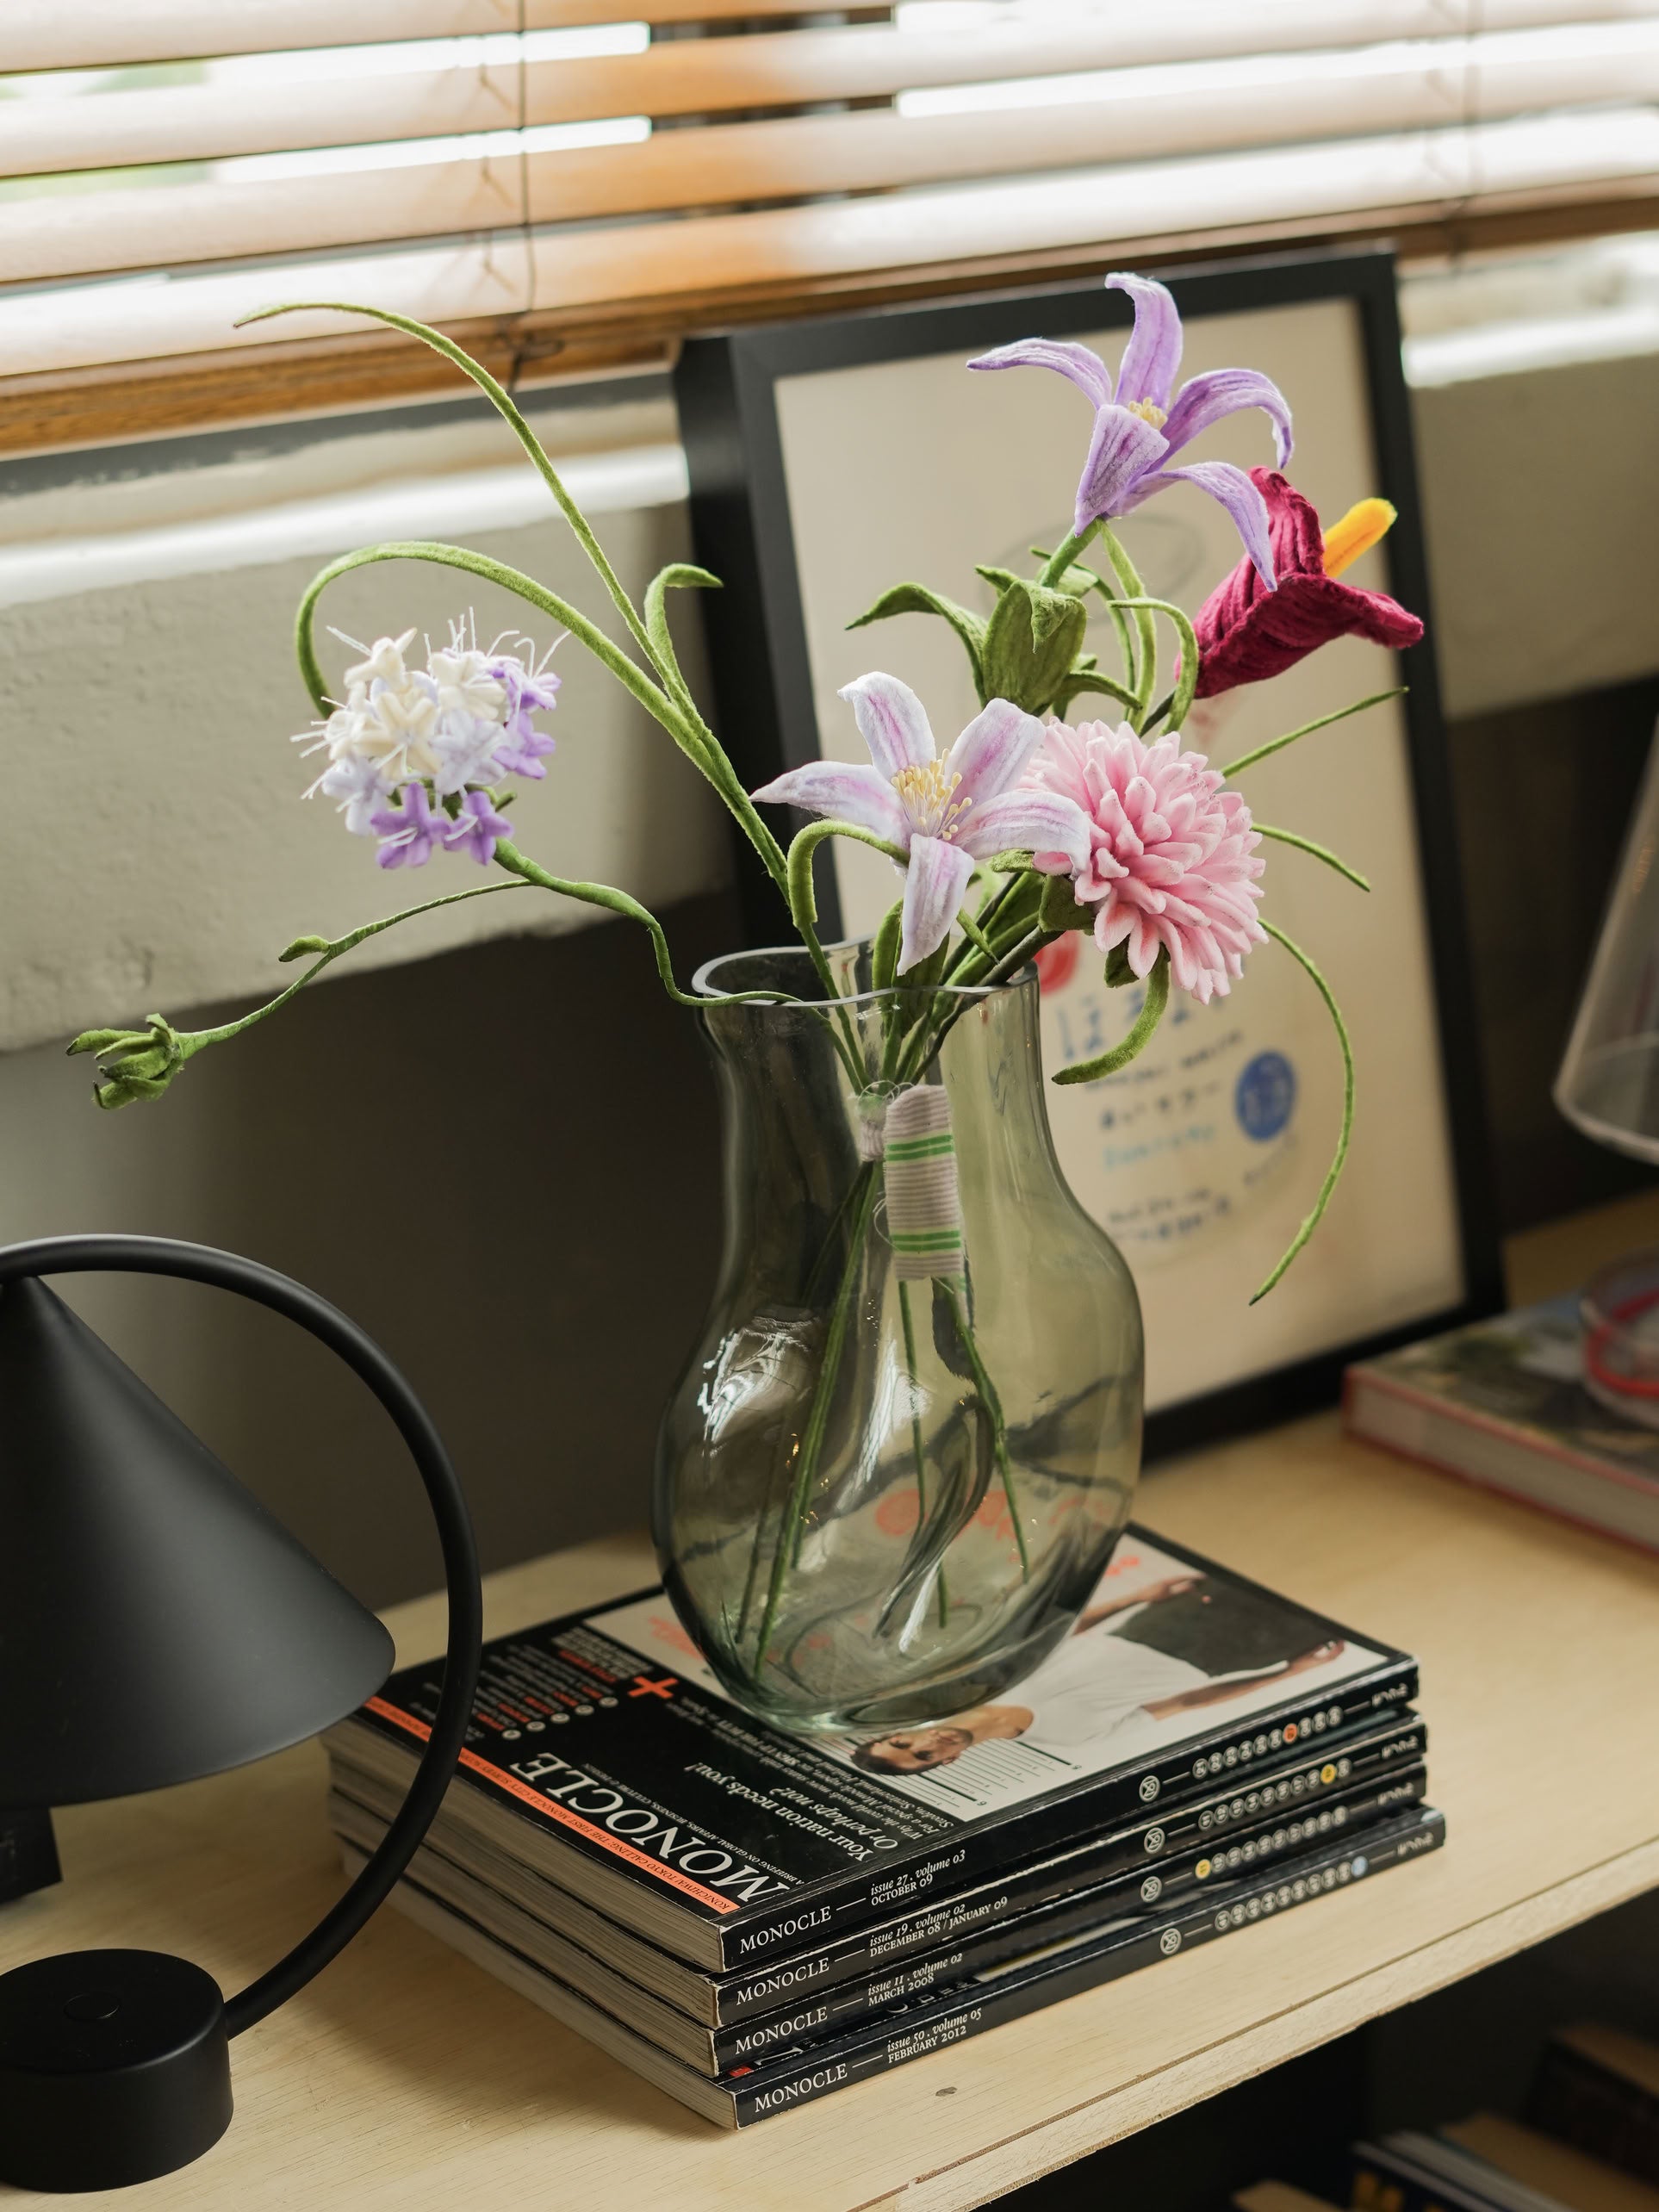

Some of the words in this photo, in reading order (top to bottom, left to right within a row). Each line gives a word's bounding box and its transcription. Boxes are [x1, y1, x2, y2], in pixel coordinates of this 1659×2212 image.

[775, 1752, 799, 1765] SIGN
[685, 1763, 735, 1784] you!
[506, 1783, 533, 1797] CITY
[618, 1785, 655, 1804] CULTURE
[726, 1782, 779, 1809] needs
[769, 1788, 813, 1805] not?
[806, 1780, 831, 1793] more
[830, 1793, 857, 1805] needs
[841, 1786, 882, 1805] Monocle
[524, 1794, 573, 1820] MONOCLE
[851, 1805, 883, 1817] world
[876, 1805, 913, 1819] special
[511, 1753, 790, 1907] MONOCLE
[564, 1817, 595, 1833] FIRST
[775, 1807, 834, 1836] nation
[809, 1805, 882, 1835] perhaps
[898, 1825, 923, 1839] Why
[919, 1824, 940, 1833] For
[587, 1830, 612, 1842] THE
[718, 1839, 747, 1855] GLOBAL
[829, 1836, 873, 1861] Your
[869, 1836, 898, 1849] Or
[604, 1840, 651, 1865] CALLING:
[643, 1861, 680, 1881] TOKYO
[759, 1861, 798, 1881] BRIEFING
[872, 1880, 893, 1895] issue
[916, 1859, 950, 1878] volume
[953, 1849, 965, 1863] 03
[872, 1882, 916, 1905] OCTOBER
[918, 1872, 932, 1886] 09
[740, 1906, 831, 1954] MONOCLE
[870, 1930, 924, 1957] DECEMBER
[927, 1919, 941, 1935] 08
[949, 1904, 991, 1929] JANUARY
[994, 1897, 1007, 1910] 09
[871, 1932, 892, 1947] issue
[897, 1923, 908, 1936] 19
[916, 1910, 950, 1929] volume
[954, 1904, 965, 1915] 02
[736, 1958, 829, 2005] MONOCLE
[868, 1980, 891, 1996] issue
[913, 1959, 948, 1979] volume
[951, 1954, 962, 1964] 02
[869, 1985, 904, 2006] MARCH
[908, 1973, 934, 1991] 2008
[736, 2007, 827, 2054] MONOCLE
[887, 2036, 910, 2053] issue
[932, 2014, 967, 2034] volume
[971, 2008, 981, 2020] 05
[888, 2036, 937, 2063] FEBRUARY
[941, 2026, 966, 2042] 2012
[755, 2063, 848, 2112] MONOCLE
